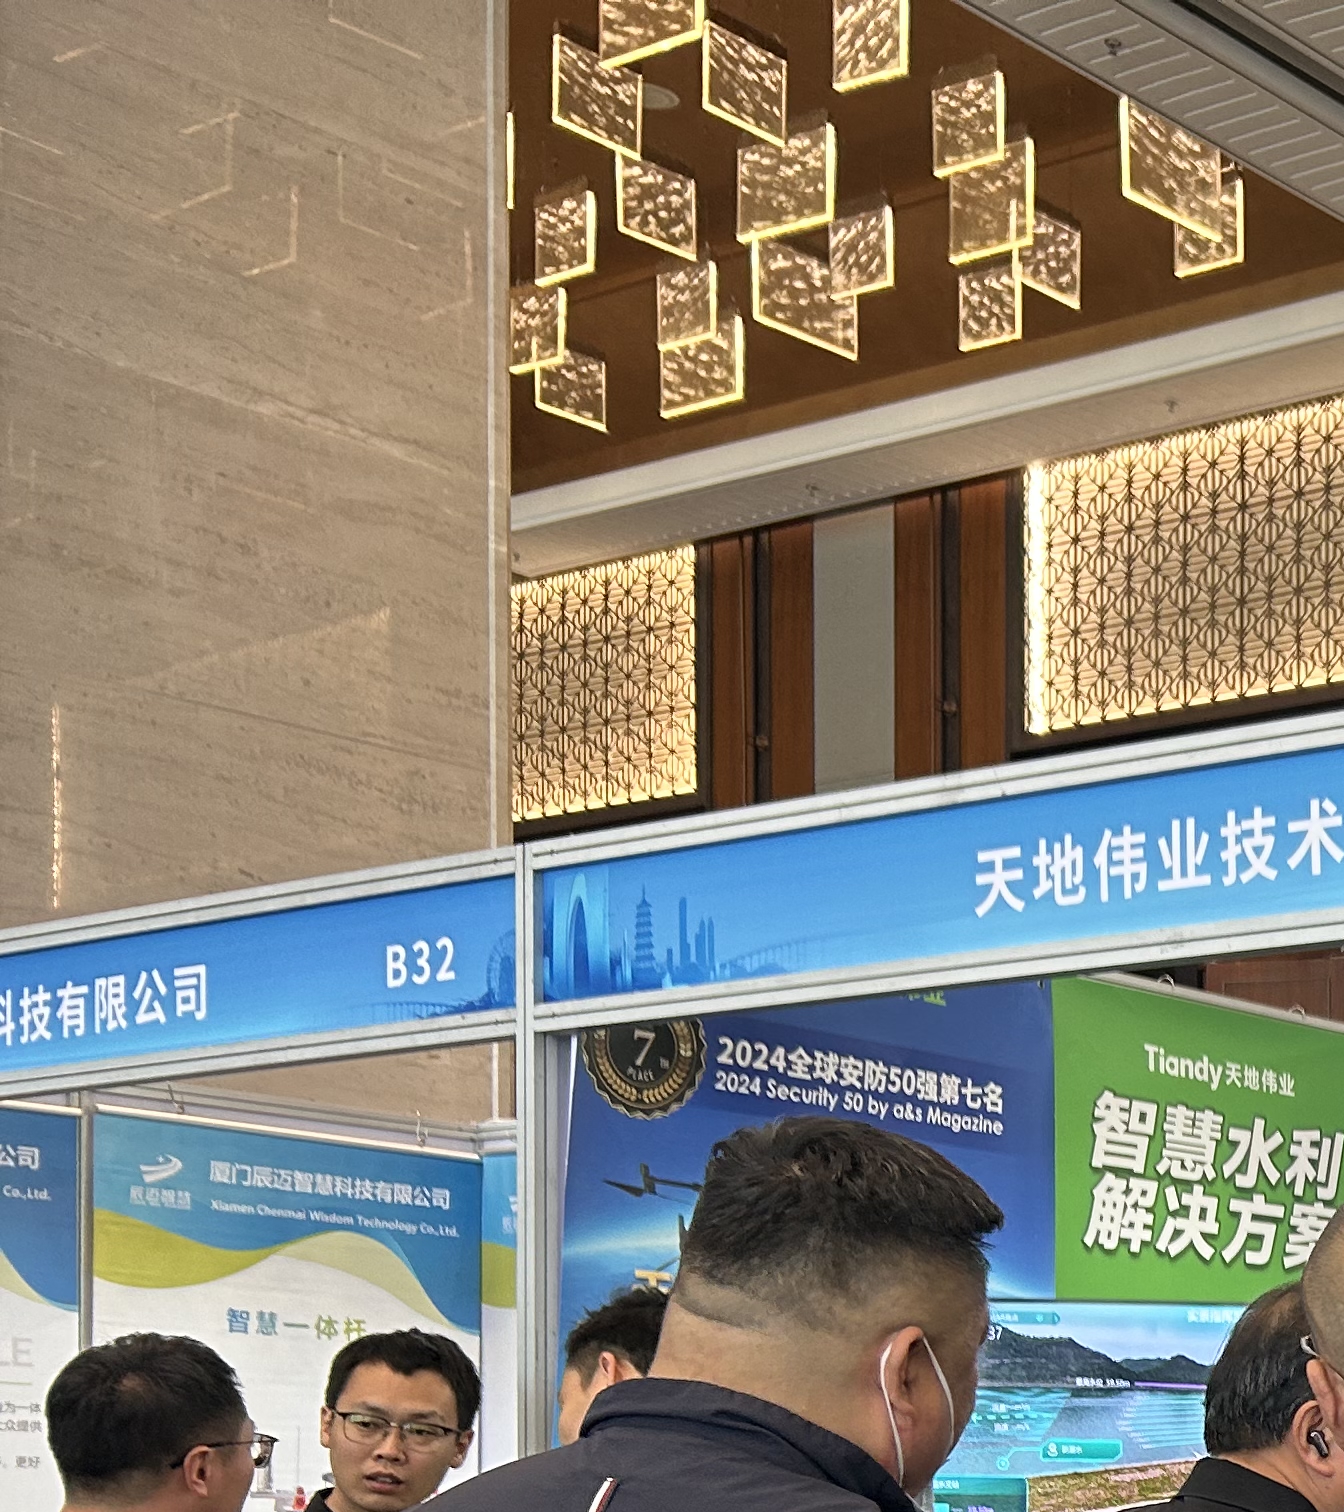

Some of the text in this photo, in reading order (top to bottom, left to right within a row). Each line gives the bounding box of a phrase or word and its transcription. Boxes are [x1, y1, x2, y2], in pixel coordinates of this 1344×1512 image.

[386, 937, 455, 988] B32
[716, 1036, 1003, 1114] 2024全球安防50强第七名
[1144, 1043, 1295, 1097] Tiandy 天地伟业
[714, 1070, 1003, 1136] 2024 Security 50 by a&s Magazine
[1092, 1090, 1344, 1200] 智慧水利
[210, 1160, 450, 1210] 厦门辰迈智慧科技有限公司
[210, 1199, 255, 1215] Xiamen
[257, 1204, 306, 1221] Chenmai
[310, 1210, 354, 1226] Wisdom
[357, 1215, 418, 1235] Technology
[1083, 1172, 1337, 1270] 解决方案
